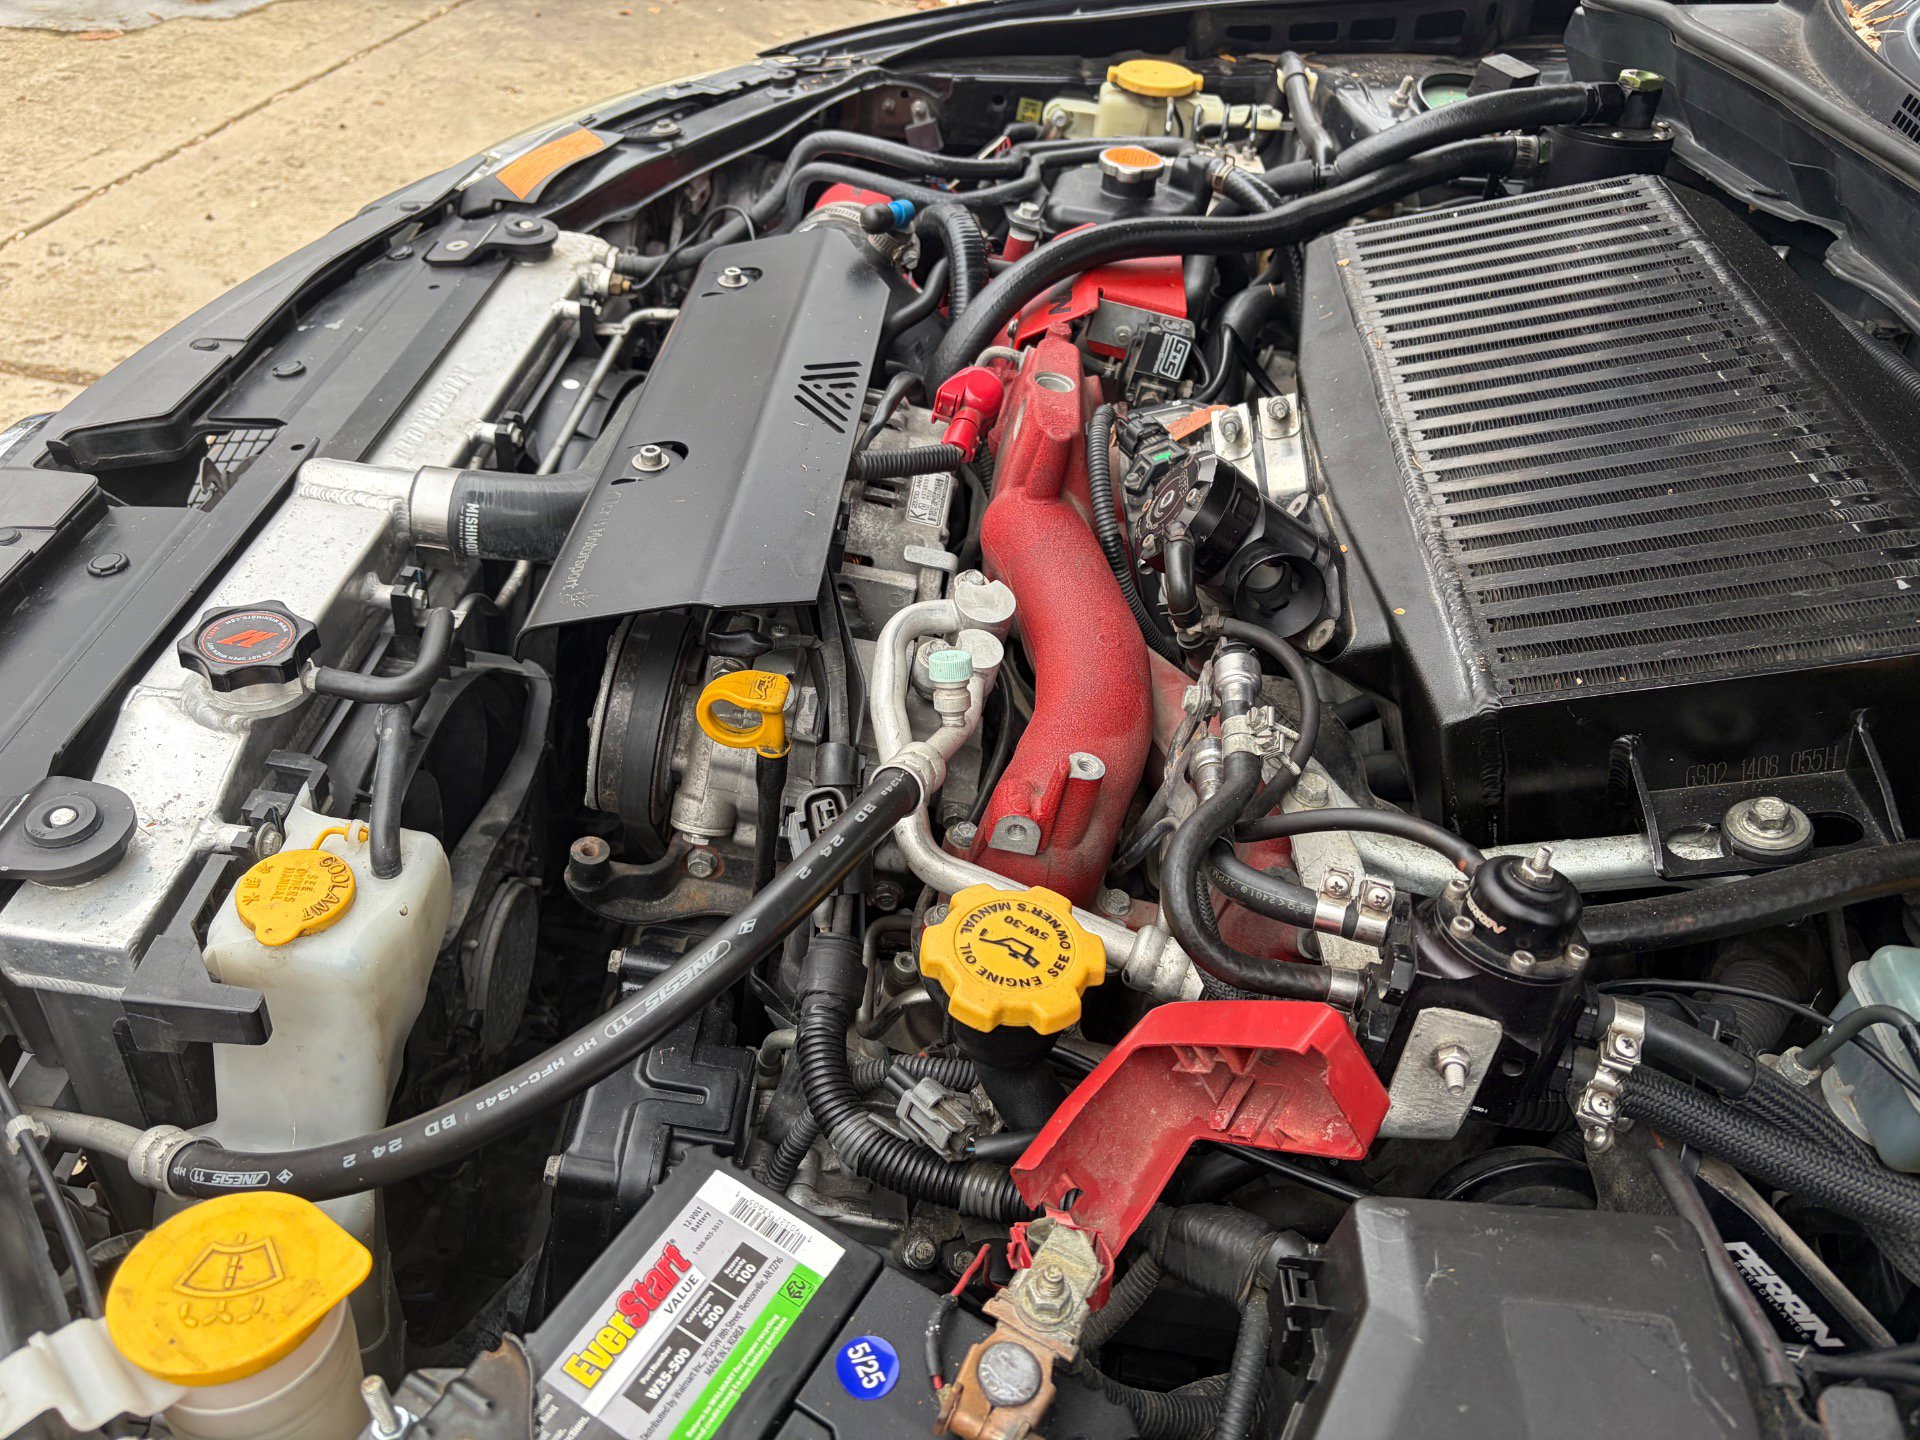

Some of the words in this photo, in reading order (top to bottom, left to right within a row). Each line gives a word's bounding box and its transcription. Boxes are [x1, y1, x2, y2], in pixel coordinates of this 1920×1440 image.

[909, 509, 927, 521] K
[1740, 755, 1779, 783] 1408
[1790, 745, 1839, 775] 055H
[879, 770, 909, 797] -134a
[854, 803, 877, 823] BD
[797, 866, 812, 879] 2
[301, 856, 350, 921] COOLANT
[959, 901, 1011, 935] MANUAL
[1004, 915, 1050, 941] 5W-30
[1017, 902, 1071, 950] OWNER'S
[959, 942, 977, 965] OIL
[1047, 953, 1071, 977] SEE
[644, 944, 721, 1011] ANESIS
[976, 965, 1042, 988] ENGINE
[573, 1036, 598, 1058] HP
[475, 1058, 566, 1111] HFC-134a
[424, 1114, 456, 1137] BD
[343, 1153, 357, 1168] 2
[371, 1137, 403, 1159] 24
[173, 1167, 186, 1176] HP
[211, 1172, 264, 1185] ANESIS
[682, 1205, 703, 1228] 12-VOLT
[690, 1210, 711, 1233] Battery
[735, 1261, 757, 1285] 100
[662, 1273, 699, 1316] VALUE
[1724, 1242, 1845, 1347] PERRIN
[1734, 1261, 1810, 1339] PERFORMANCE
[701, 1303, 725, 1329] 500
[671, 1369, 696, 1400] Walmart
[724, 1309, 743, 1330] Street
[738, 1276, 768, 1312] Bentonville,
[703, 1356, 721, 1376] MADE
[726, 1323, 746, 1346] KOREA
[644, 1345, 692, 1401] W35-500
[847, 1342, 886, 1389] 5/25
[707, 1371, 737, 1407] WALMART
